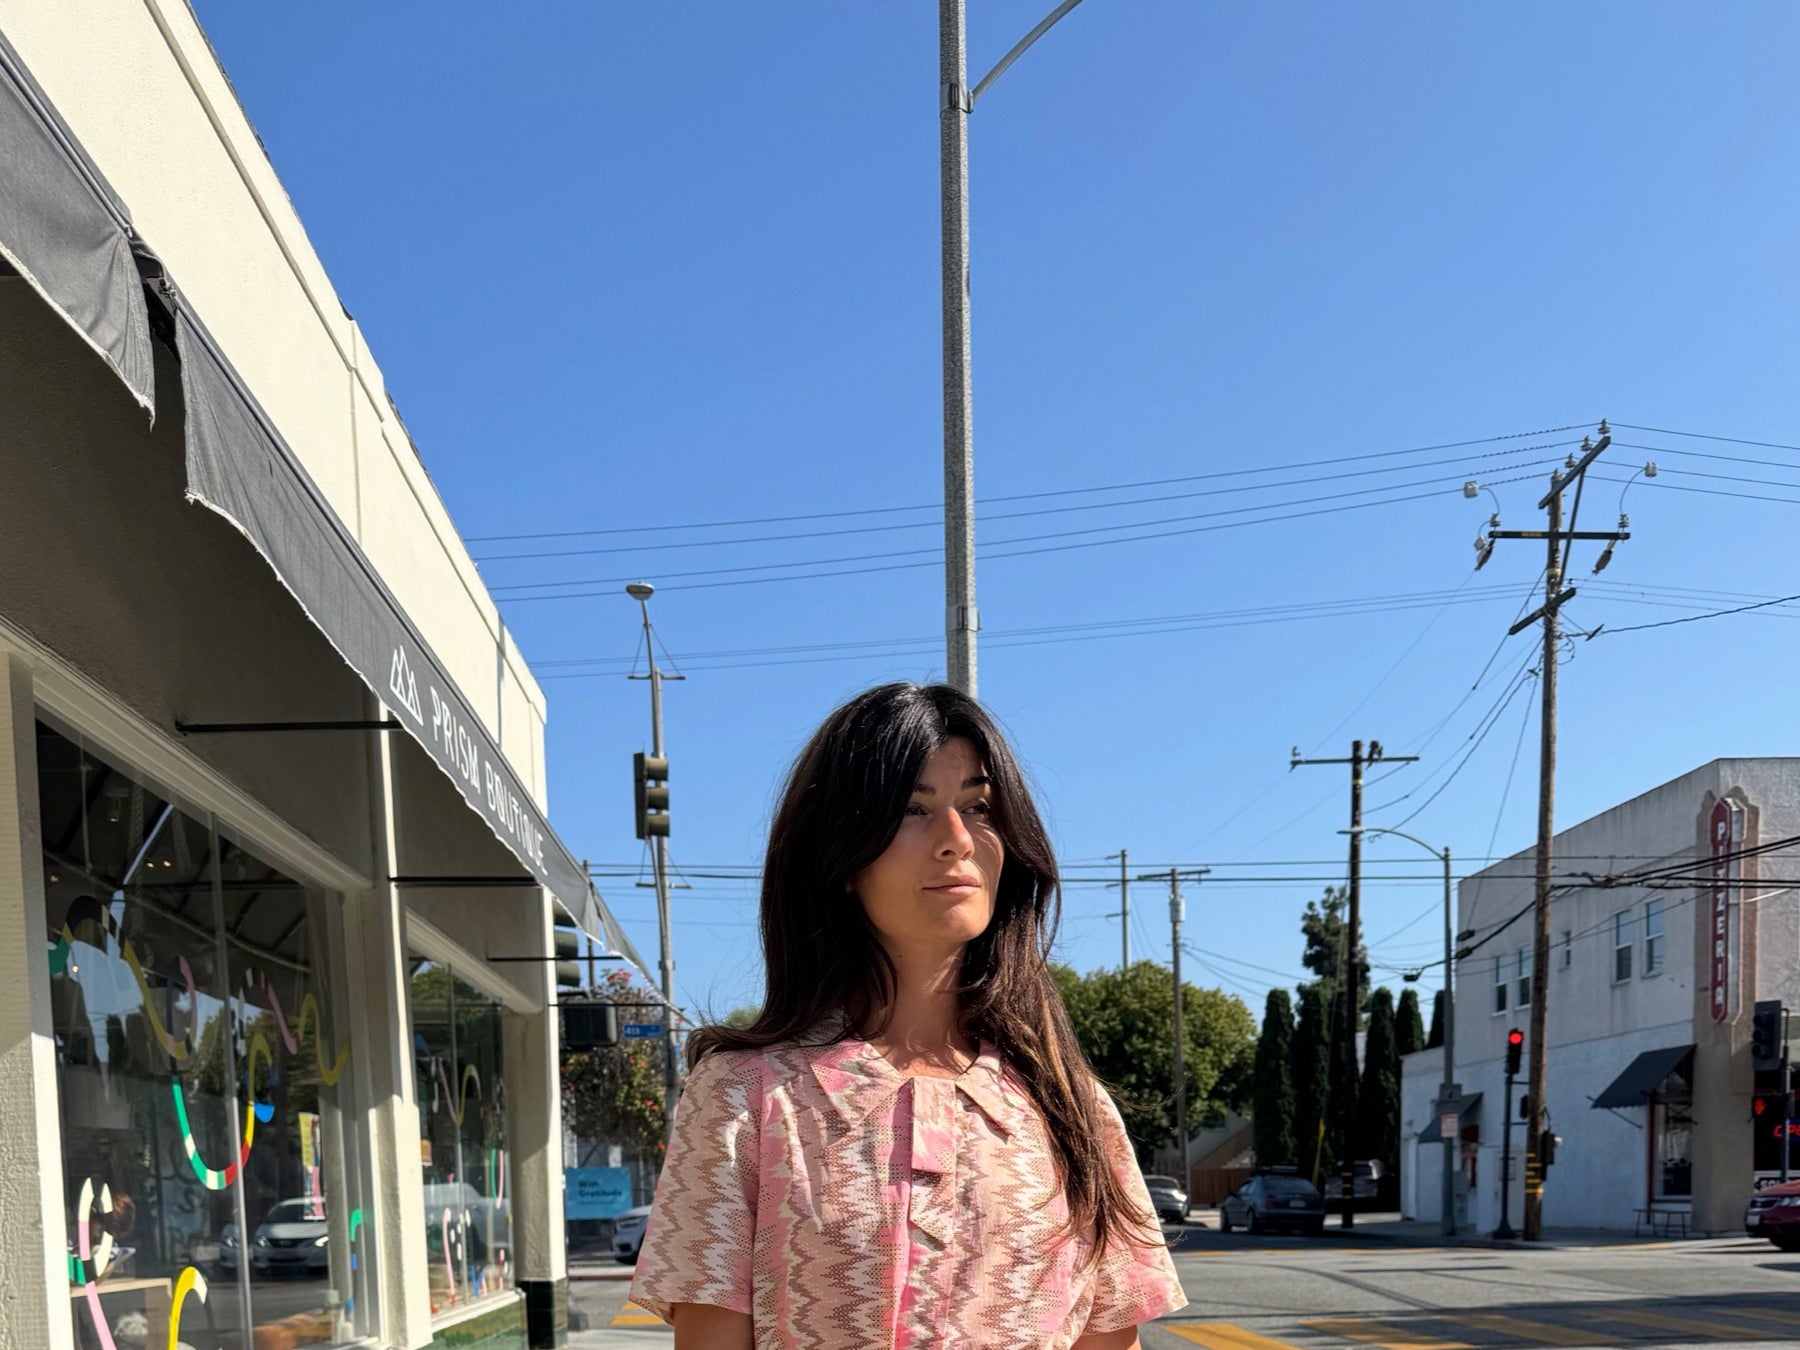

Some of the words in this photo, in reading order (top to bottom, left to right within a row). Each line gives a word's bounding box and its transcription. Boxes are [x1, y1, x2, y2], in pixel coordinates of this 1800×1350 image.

[430, 685, 481, 794] PRISM
[484, 760, 549, 876] BOUTIQUE
[1716, 821, 1727, 1005] PIZZERIA
